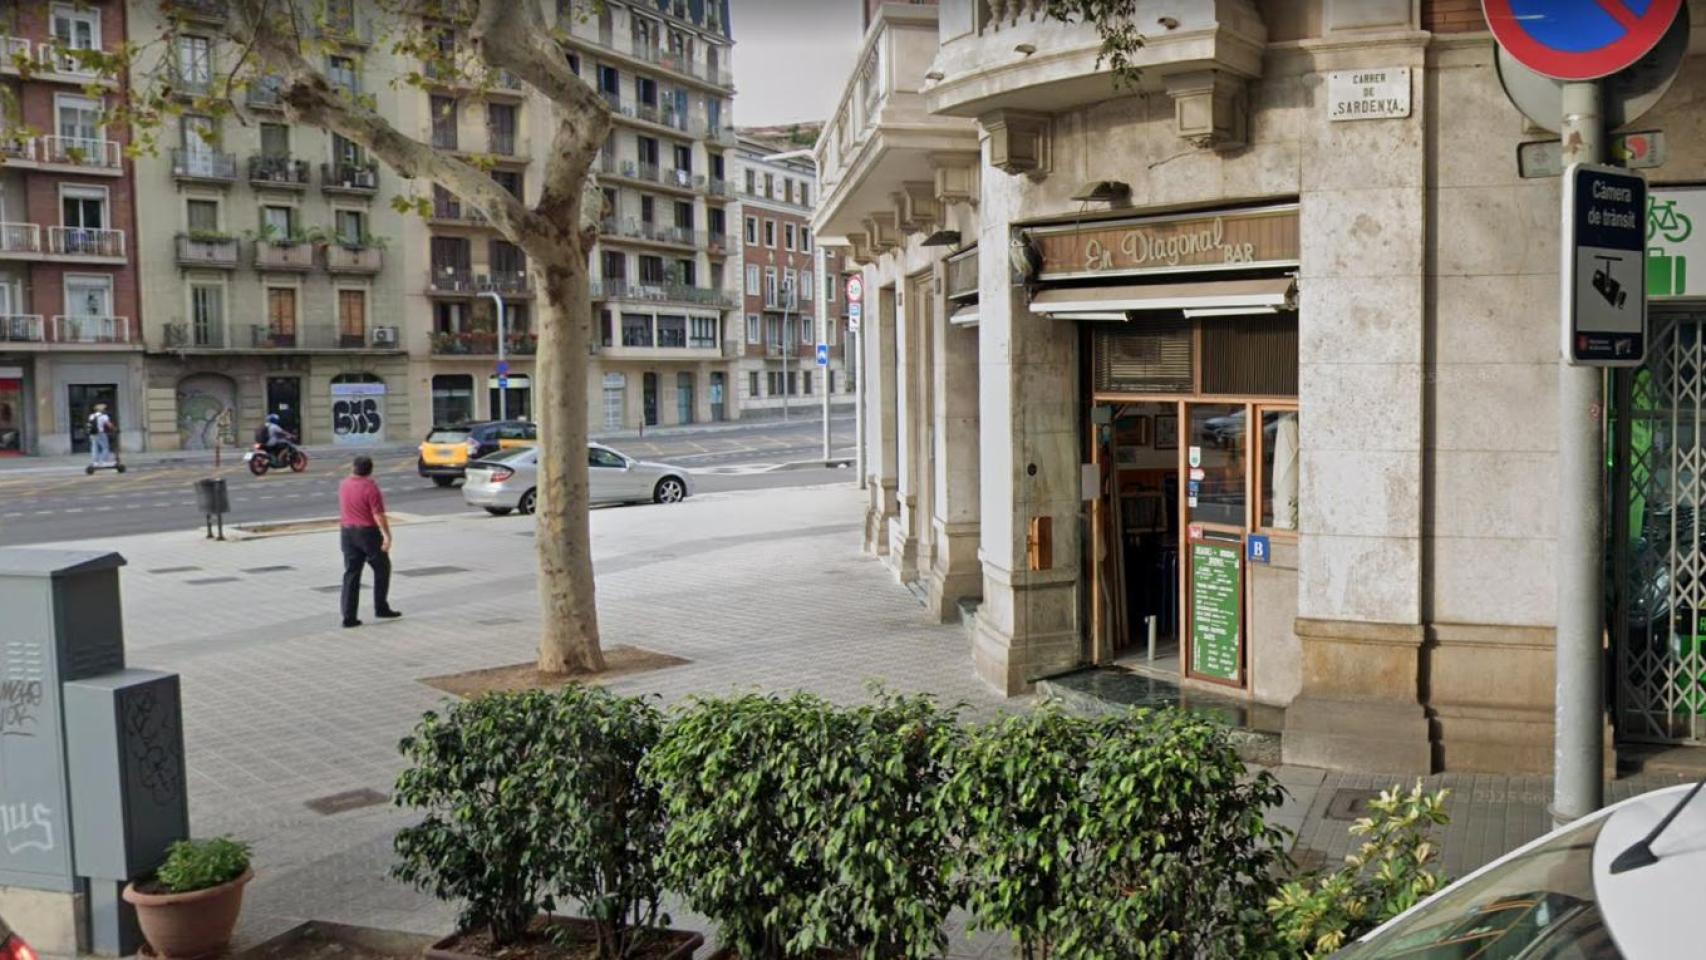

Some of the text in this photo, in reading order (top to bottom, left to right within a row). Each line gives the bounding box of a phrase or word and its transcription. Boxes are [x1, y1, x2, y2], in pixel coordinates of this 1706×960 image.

[1352, 73, 1386, 84] CARRER
[1363, 87, 1375, 97] DE
[1338, 99, 1398, 114] SARDENYA
[1592, 180, 1632, 202] Càmera
[1588, 206, 1601, 225] de
[1085, 216, 1254, 272] En Diagonal BAR
[1254, 541, 1263, 556] B
